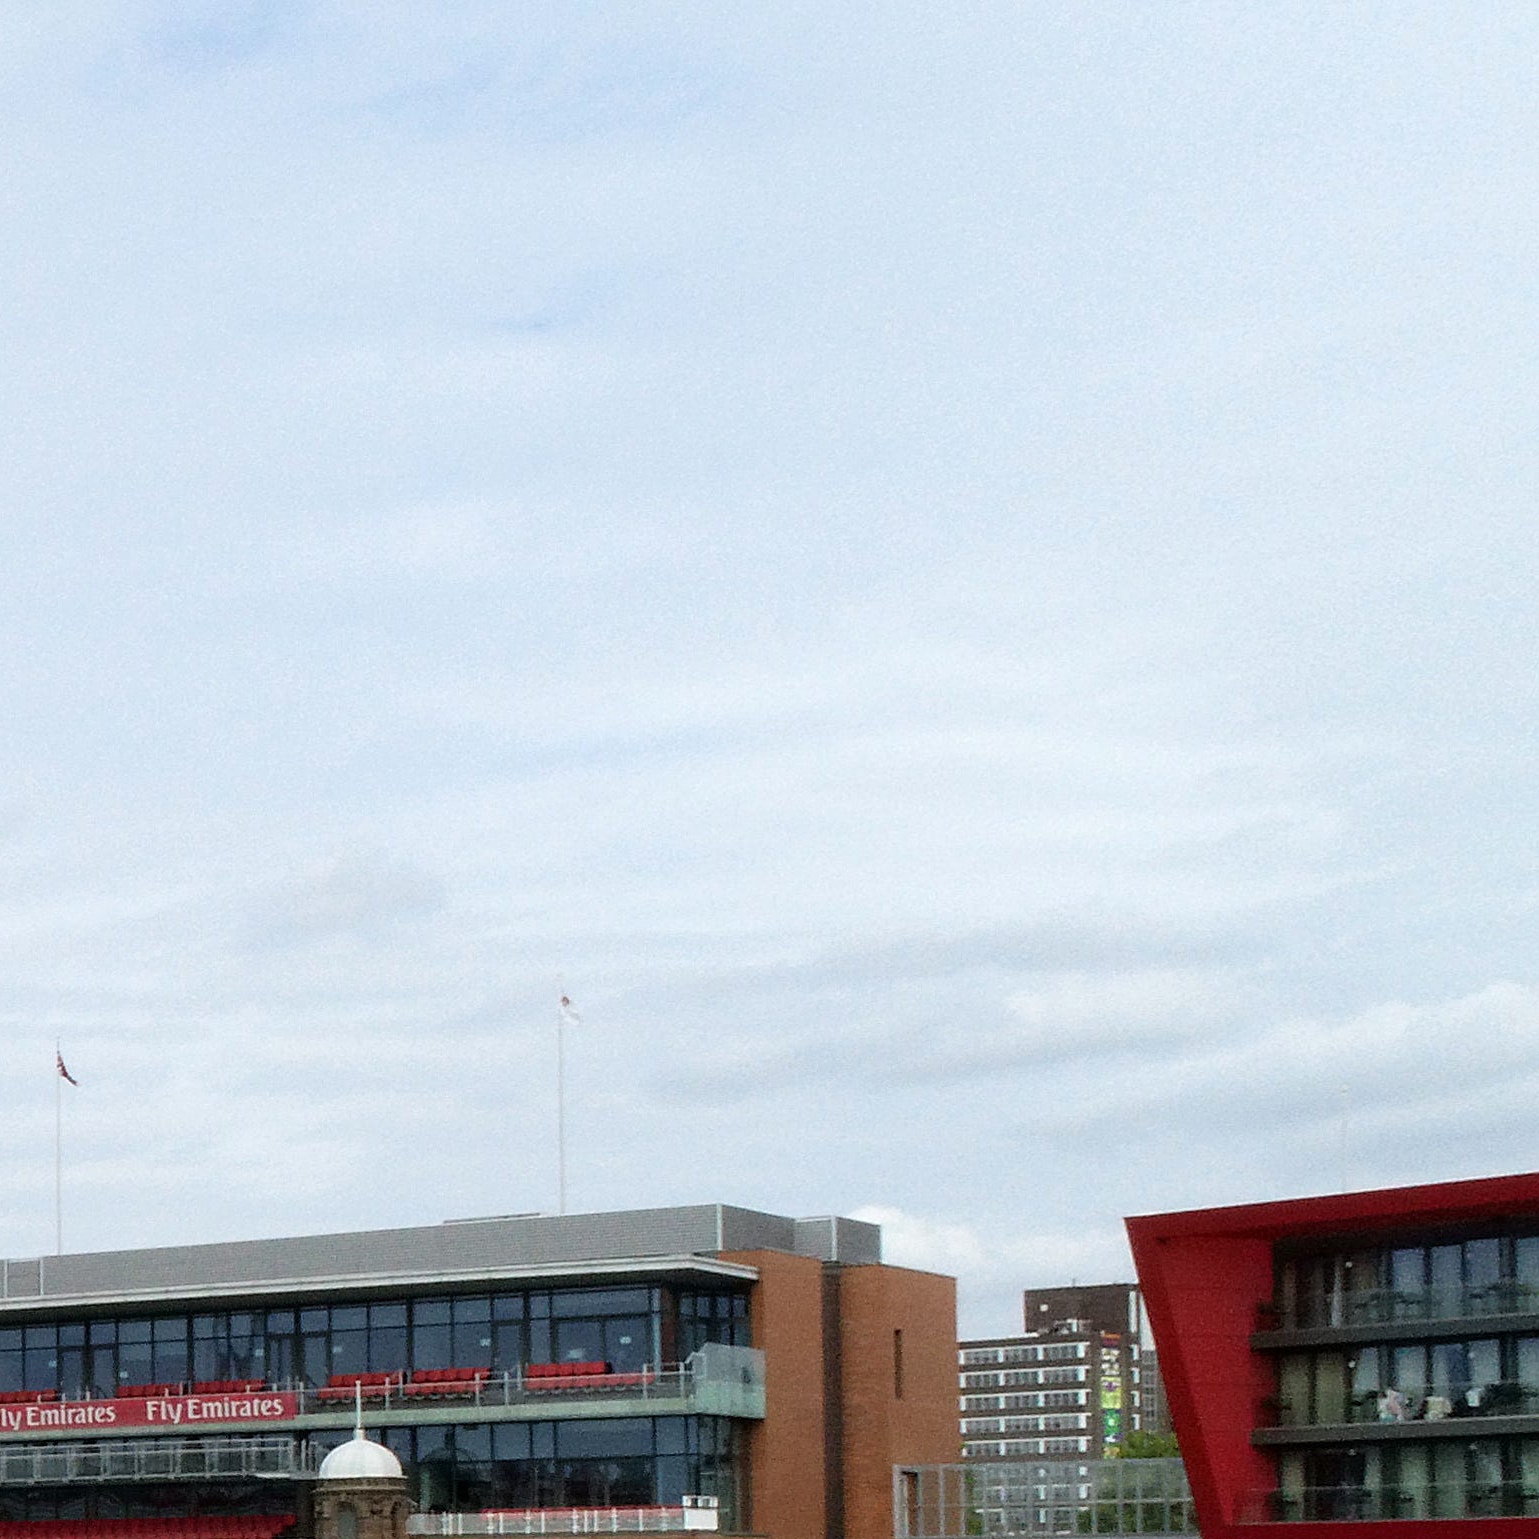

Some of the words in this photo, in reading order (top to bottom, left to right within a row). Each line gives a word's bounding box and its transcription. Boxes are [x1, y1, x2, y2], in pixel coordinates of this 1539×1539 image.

[26, 1404, 116, 1426] Emirates
[146, 1401, 182, 1424] Fly
[187, 1397, 283, 1419] Emirates
